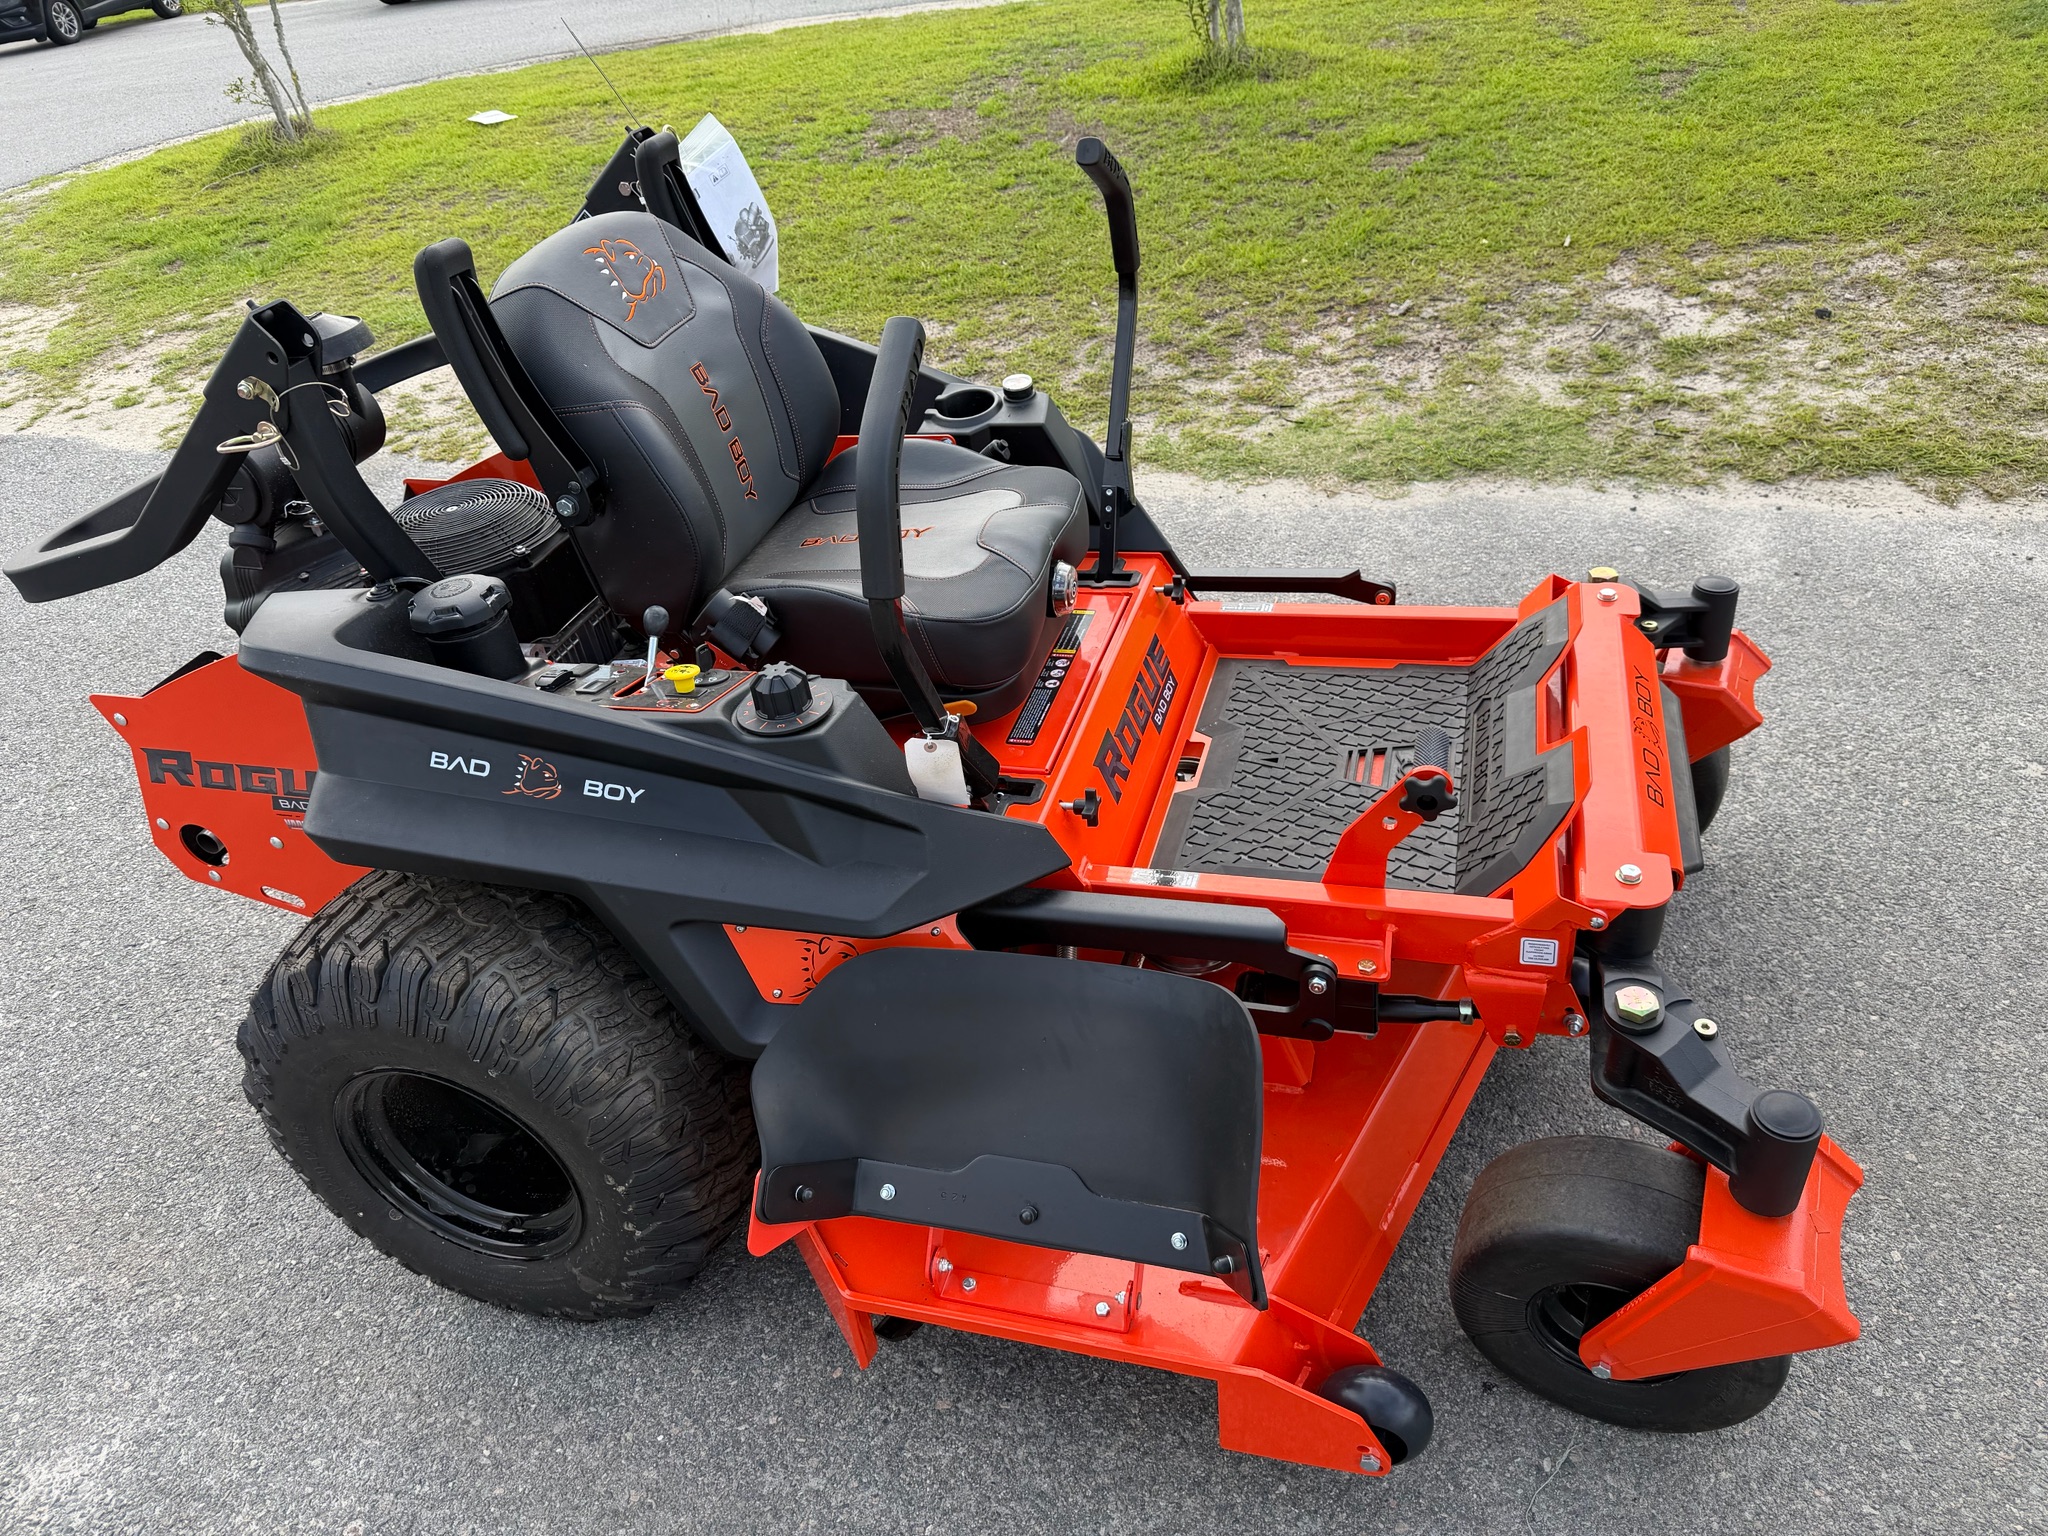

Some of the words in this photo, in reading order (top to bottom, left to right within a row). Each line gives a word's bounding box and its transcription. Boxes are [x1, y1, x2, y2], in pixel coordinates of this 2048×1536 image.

[690, 361, 733, 433] BAD
[727, 436, 758, 500] BOY
[1154, 699, 1168, 726] BAD
[1162, 675, 1176, 701] BOY
[1633, 664, 1654, 719] BOY
[1093, 633, 1171, 806] ROGUE
[1475, 708, 1491, 758] BAD
[140, 747, 318, 798] ROGU
[429, 751, 491, 777] BAD
[582, 779, 646, 804] BOY
[1472, 757, 1489, 806] BOY
[1643, 748, 1664, 808] BAD
